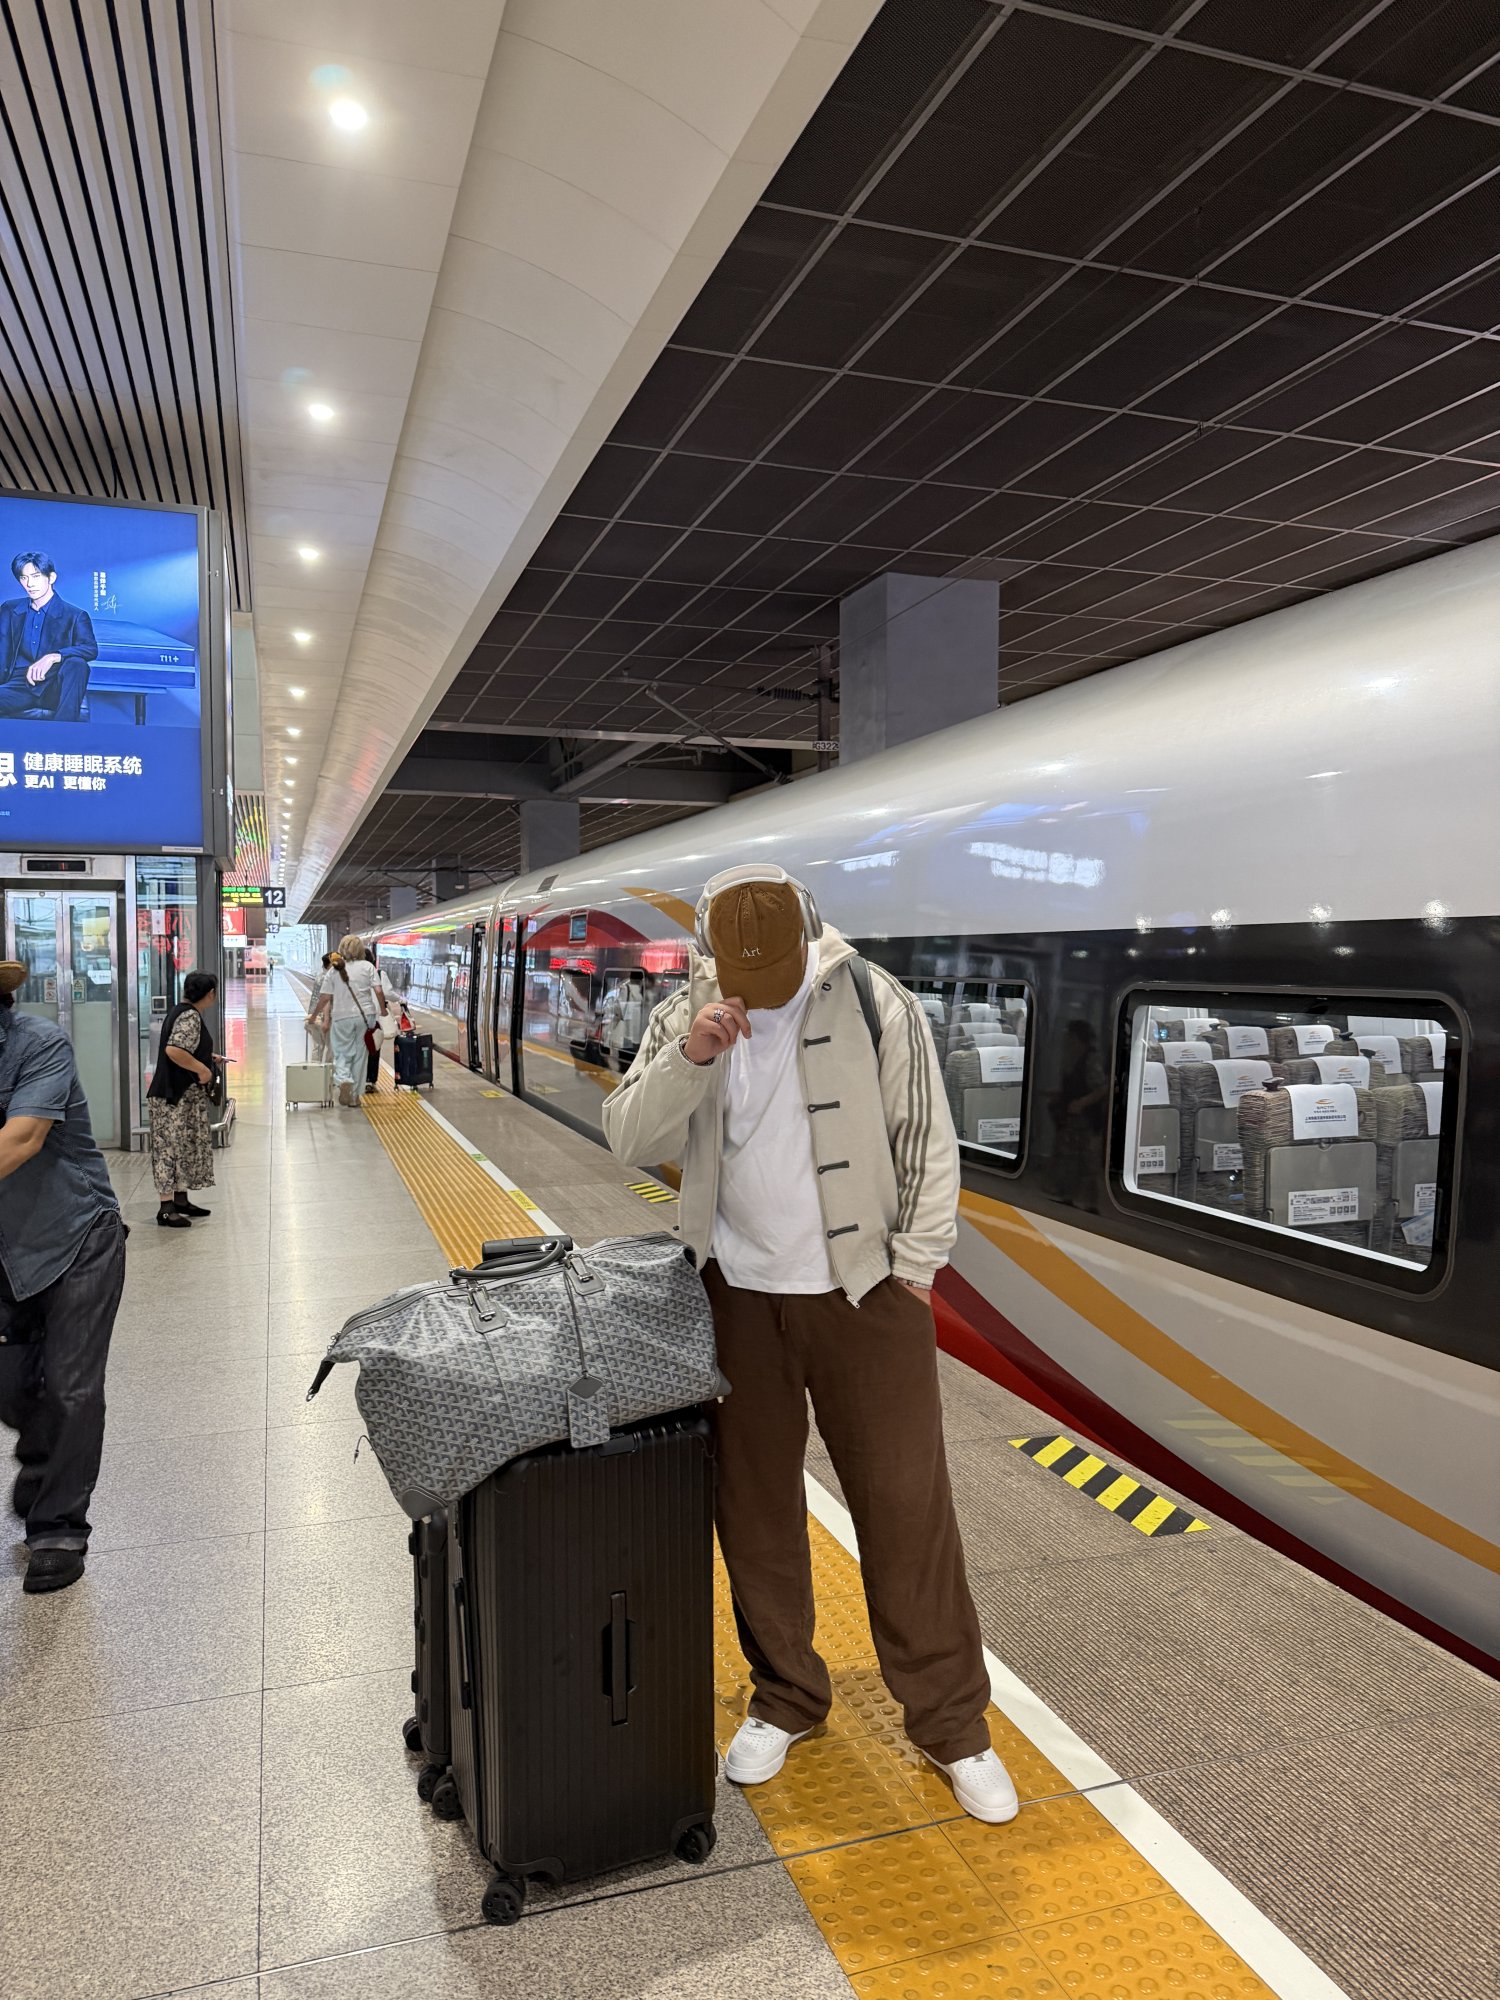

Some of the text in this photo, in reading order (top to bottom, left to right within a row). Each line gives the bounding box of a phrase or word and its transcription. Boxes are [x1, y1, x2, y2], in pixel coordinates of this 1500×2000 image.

[159, 654, 180, 663] T11+
[23, 752, 143, 775] 健康睡眠系统
[24, 774, 107, 791] 更AI 更懂你
[264, 889, 284, 905] 12
[268, 924, 279, 933] 12
[742, 947, 762, 957] Art
